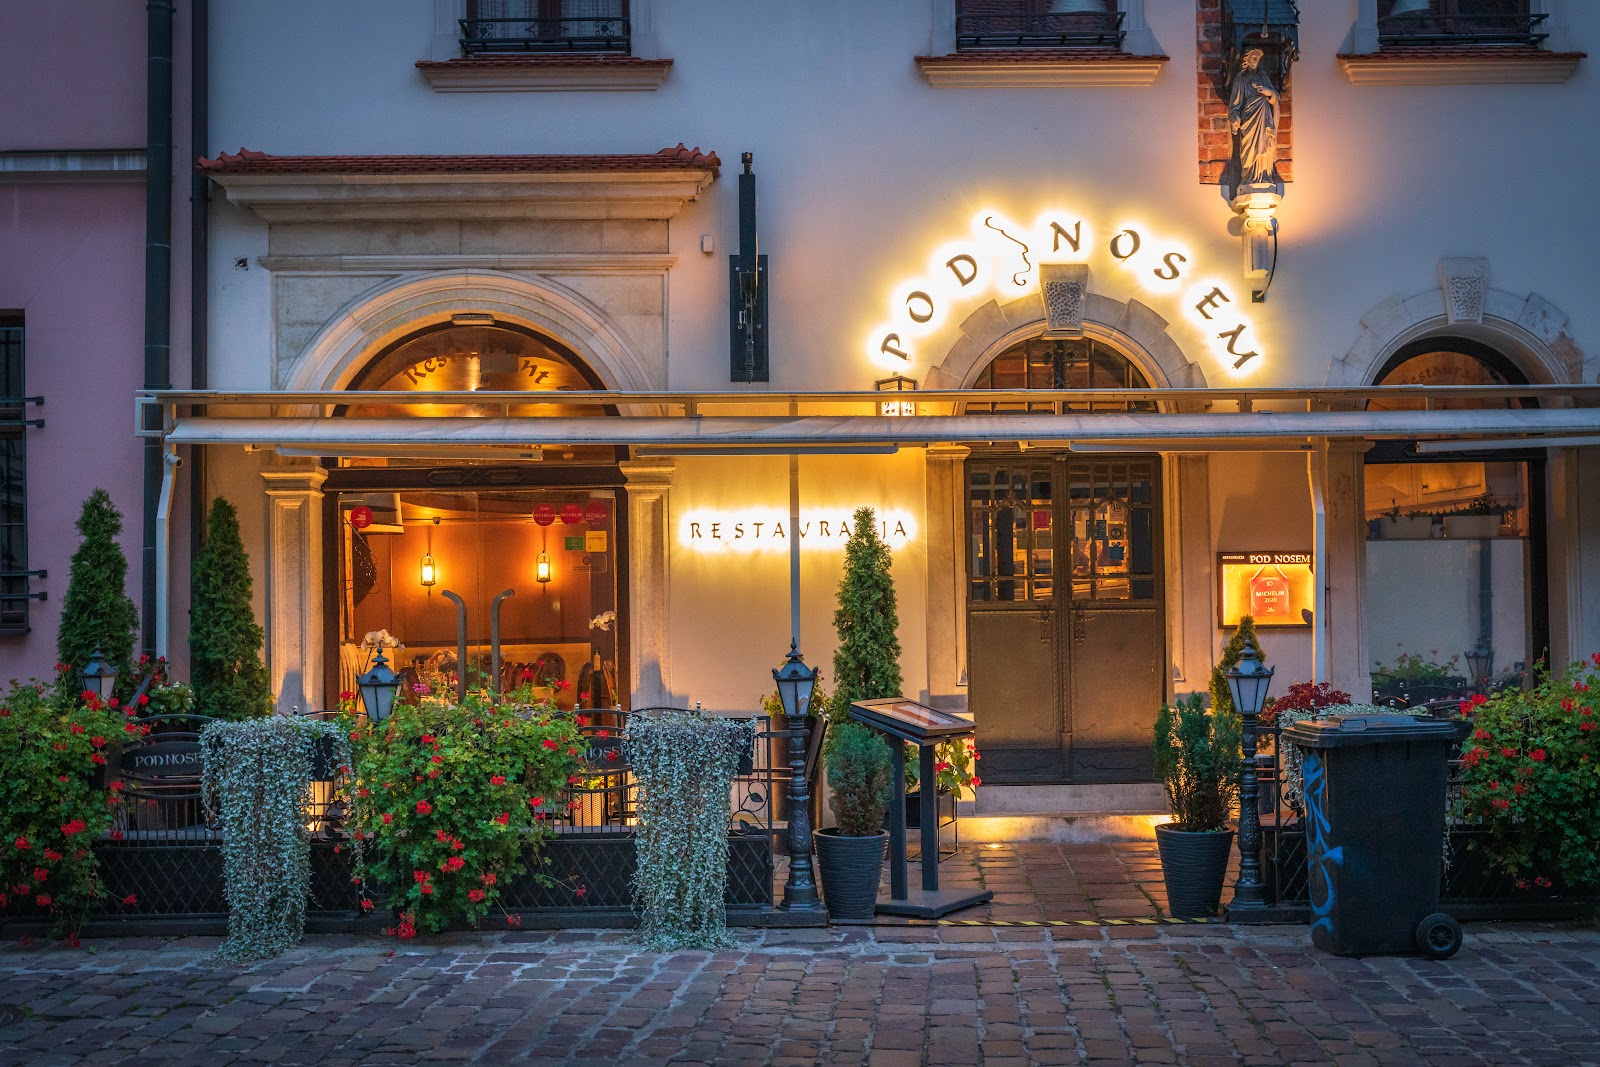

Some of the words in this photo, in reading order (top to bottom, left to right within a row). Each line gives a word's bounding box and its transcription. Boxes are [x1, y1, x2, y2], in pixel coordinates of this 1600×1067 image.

[880, 253, 978, 361] POD
[1049, 220, 1259, 370] NOSEM
[690, 520, 907, 539] RESTAVRAJA
[1250, 555, 1271, 563] POD
[1274, 555, 1310, 563] NOSEM
[135, 755, 164, 767] POD
[165, 752, 203, 765] NOSE
